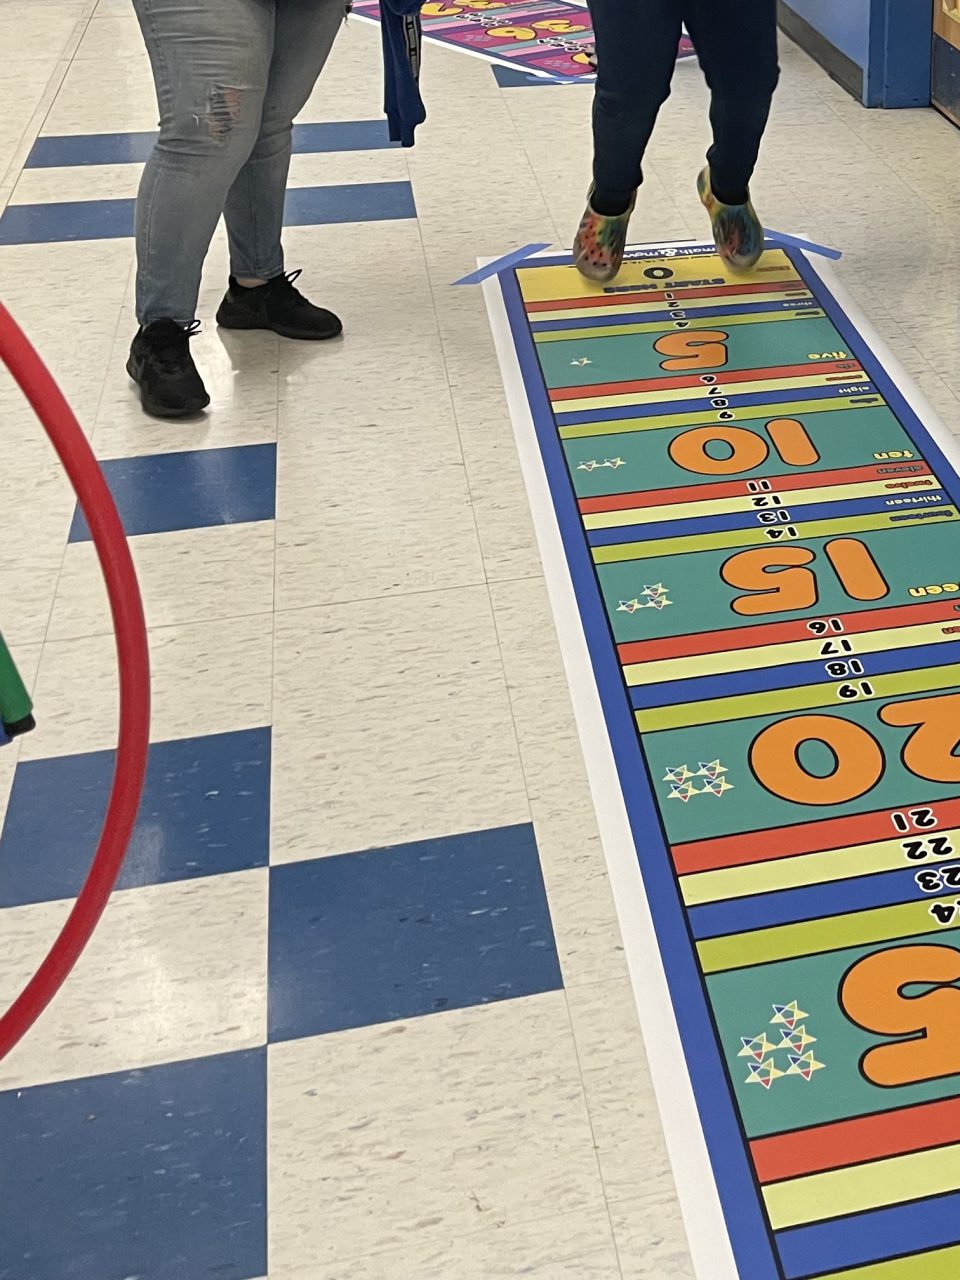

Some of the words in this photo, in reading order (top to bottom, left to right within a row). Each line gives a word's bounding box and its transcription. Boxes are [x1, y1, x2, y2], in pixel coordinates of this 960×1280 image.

[643, 267, 674, 280] 0
[653, 330, 729, 371] 5
[807, 350, 848, 360] five
[710, 397, 729, 409] 8
[718, 409, 735, 420] 9
[667, 418, 821, 475] 10
[873, 449, 915, 461] ten
[747, 479, 771, 493] 11
[750, 494, 783, 507] 12
[885, 494, 942, 507] thirteen
[757, 509, 790, 523] 13
[764, 526, 799, 541] 14
[720, 537, 890, 616] 15
[806, 617, 844, 635] 16
[819, 638, 853, 656] 17
[825, 658, 864, 677] 18
[837, 680, 874, 700] 19
[890, 807, 939, 831] 21
[900, 834, 954, 861] 22
